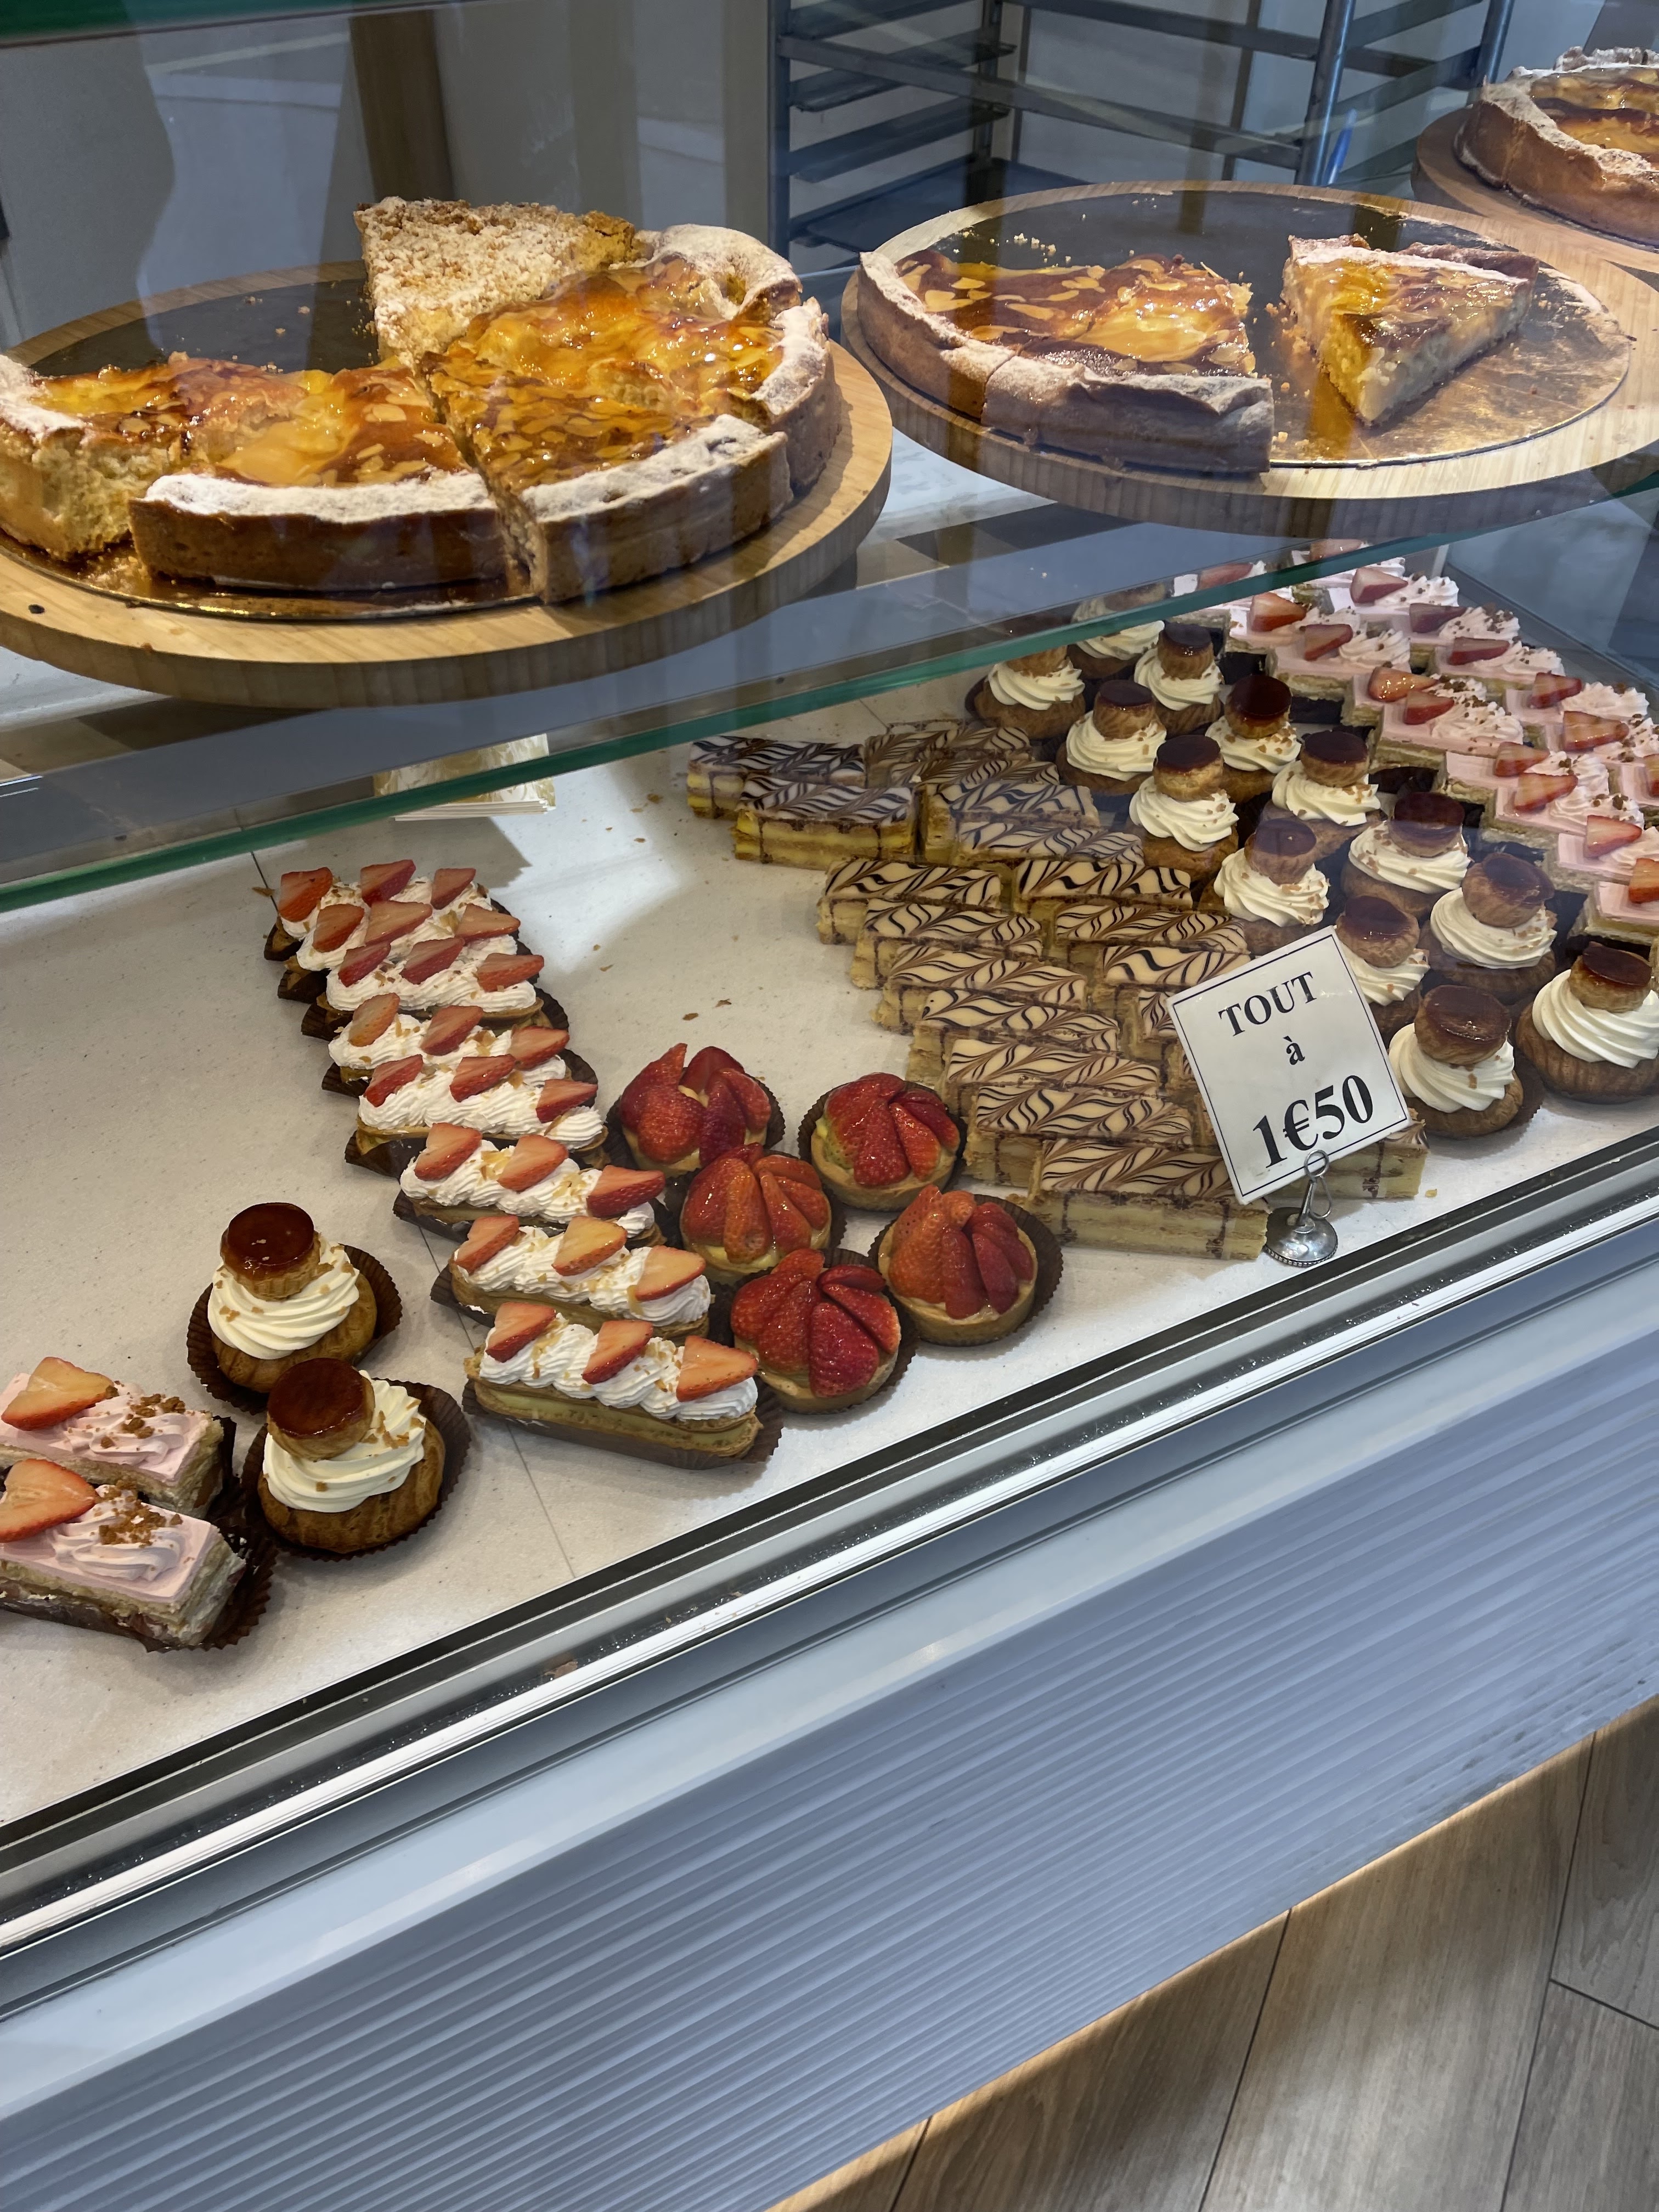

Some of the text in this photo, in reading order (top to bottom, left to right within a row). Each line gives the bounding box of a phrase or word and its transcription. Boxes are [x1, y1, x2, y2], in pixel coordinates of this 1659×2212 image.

[1218, 971, 1317, 1036] TOUT
[1283, 1036, 1305, 1065] à
[1252, 1075, 1373, 1169] 1€50
